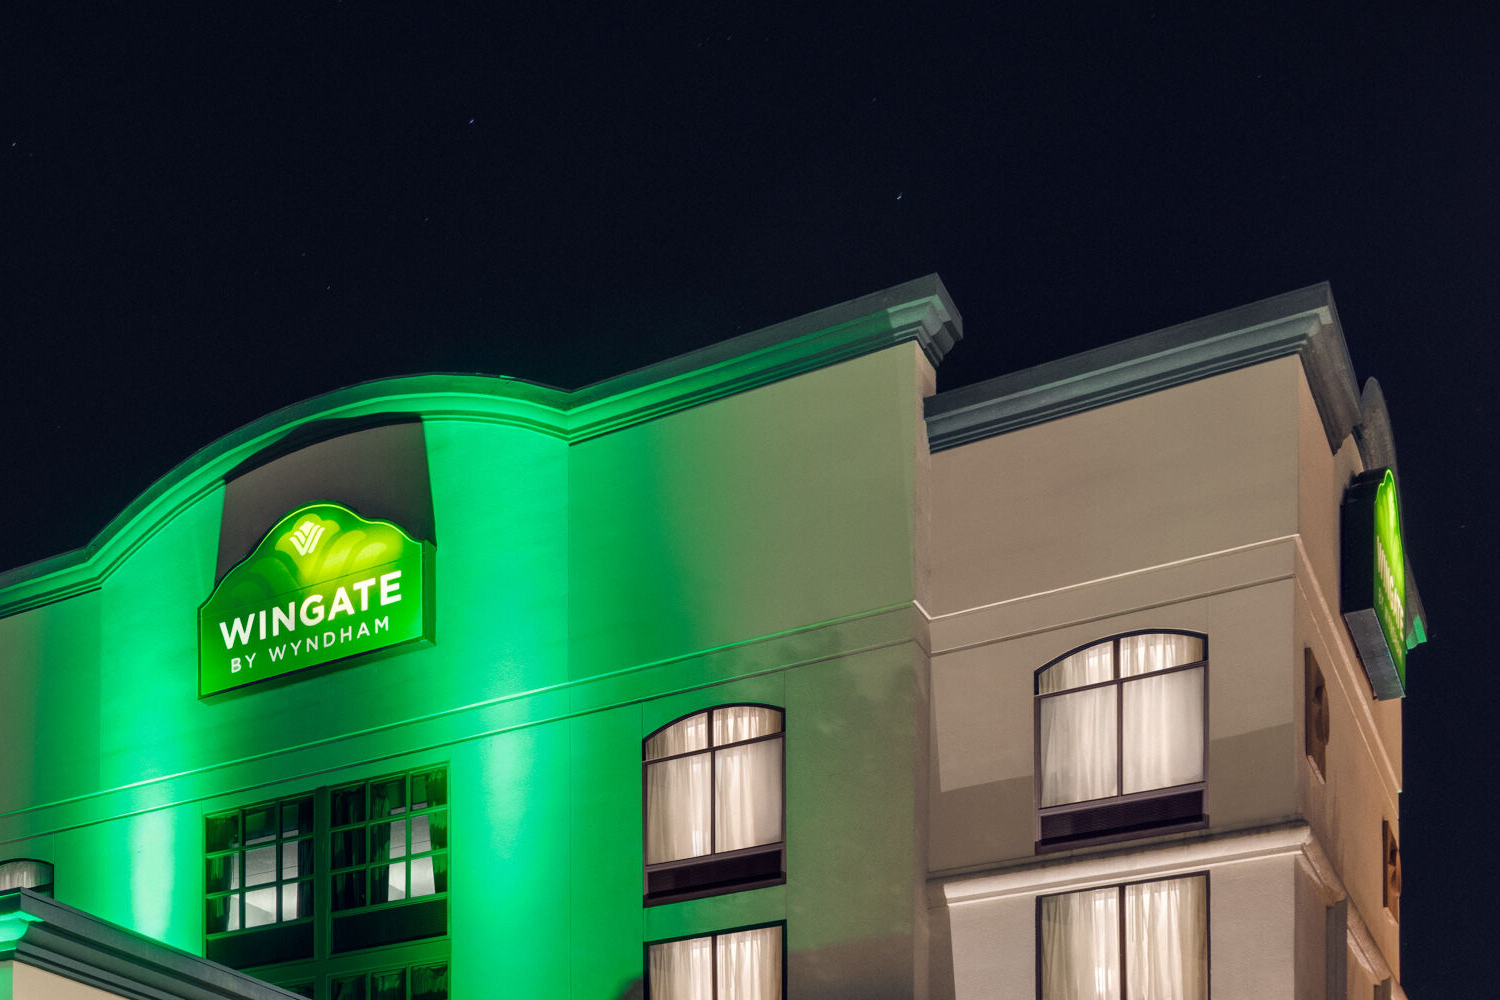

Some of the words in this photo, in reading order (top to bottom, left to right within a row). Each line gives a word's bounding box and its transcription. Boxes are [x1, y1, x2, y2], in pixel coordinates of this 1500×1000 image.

[219, 570, 402, 650] WINGATE
[230, 652, 257, 674] BY
[268, 615, 389, 663] WYNDHAM
